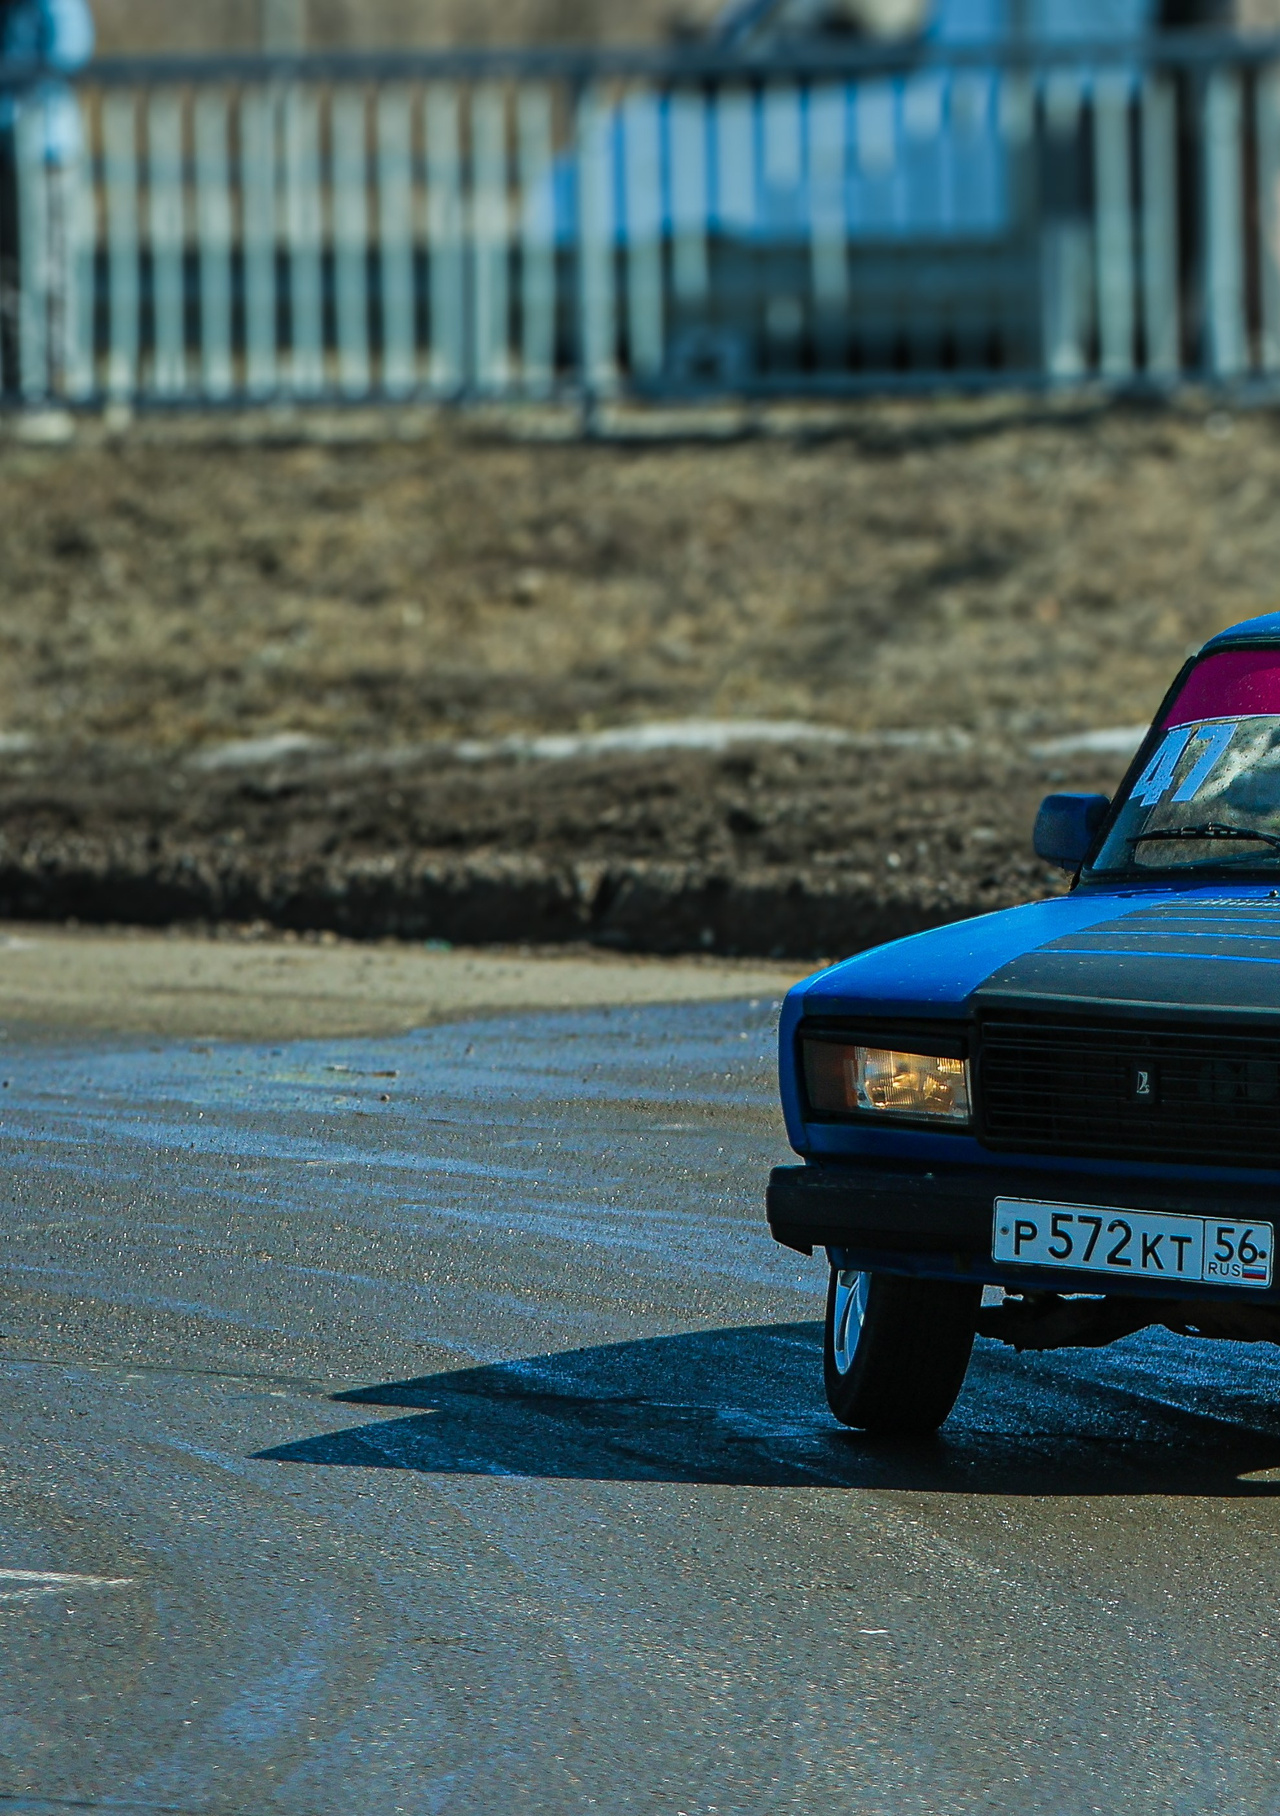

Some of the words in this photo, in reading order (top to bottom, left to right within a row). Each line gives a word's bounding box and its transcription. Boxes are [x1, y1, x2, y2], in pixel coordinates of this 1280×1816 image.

[1128, 723, 1238, 807] 47
[1213, 1226, 1259, 1263] 56
[1207, 1262, 1241, 1277] RUS
